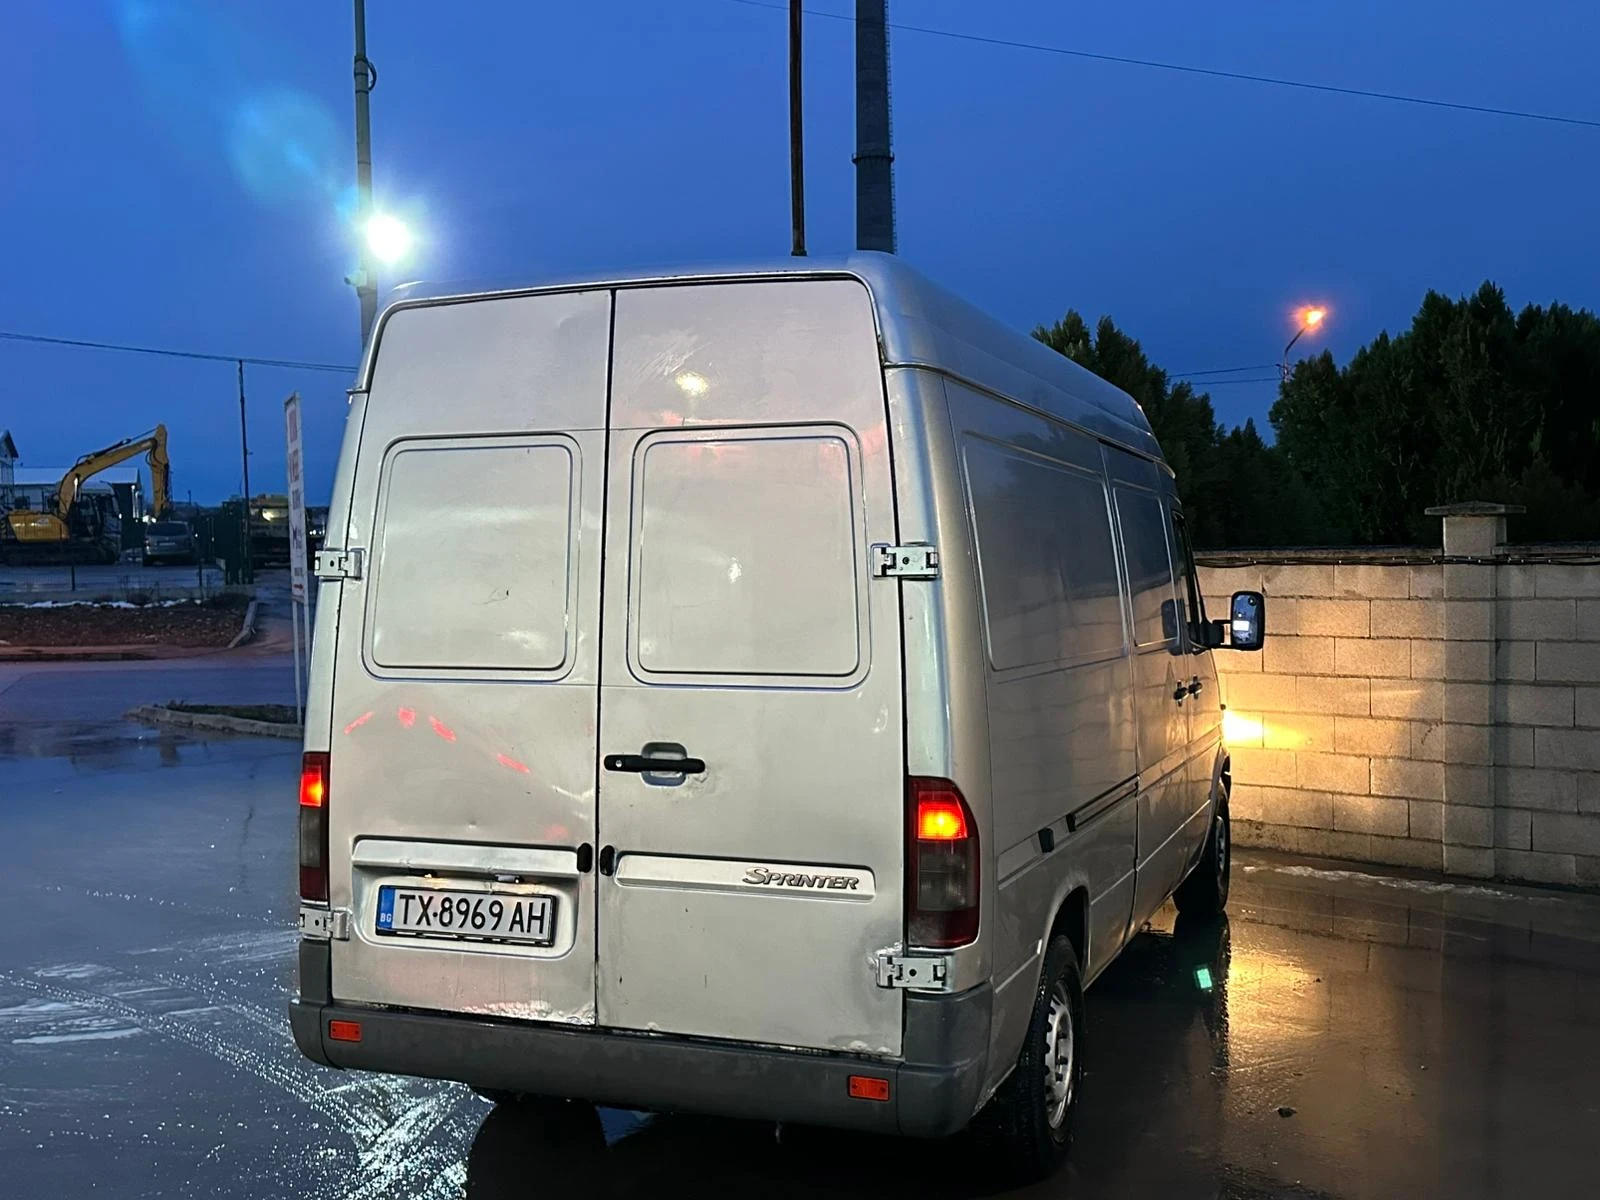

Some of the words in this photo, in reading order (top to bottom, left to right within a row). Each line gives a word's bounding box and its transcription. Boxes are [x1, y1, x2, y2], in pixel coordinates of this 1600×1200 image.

[742, 866, 860, 890] SPRINTER
[379, 913, 392, 923] BG
[508, 902, 546, 934] AH
